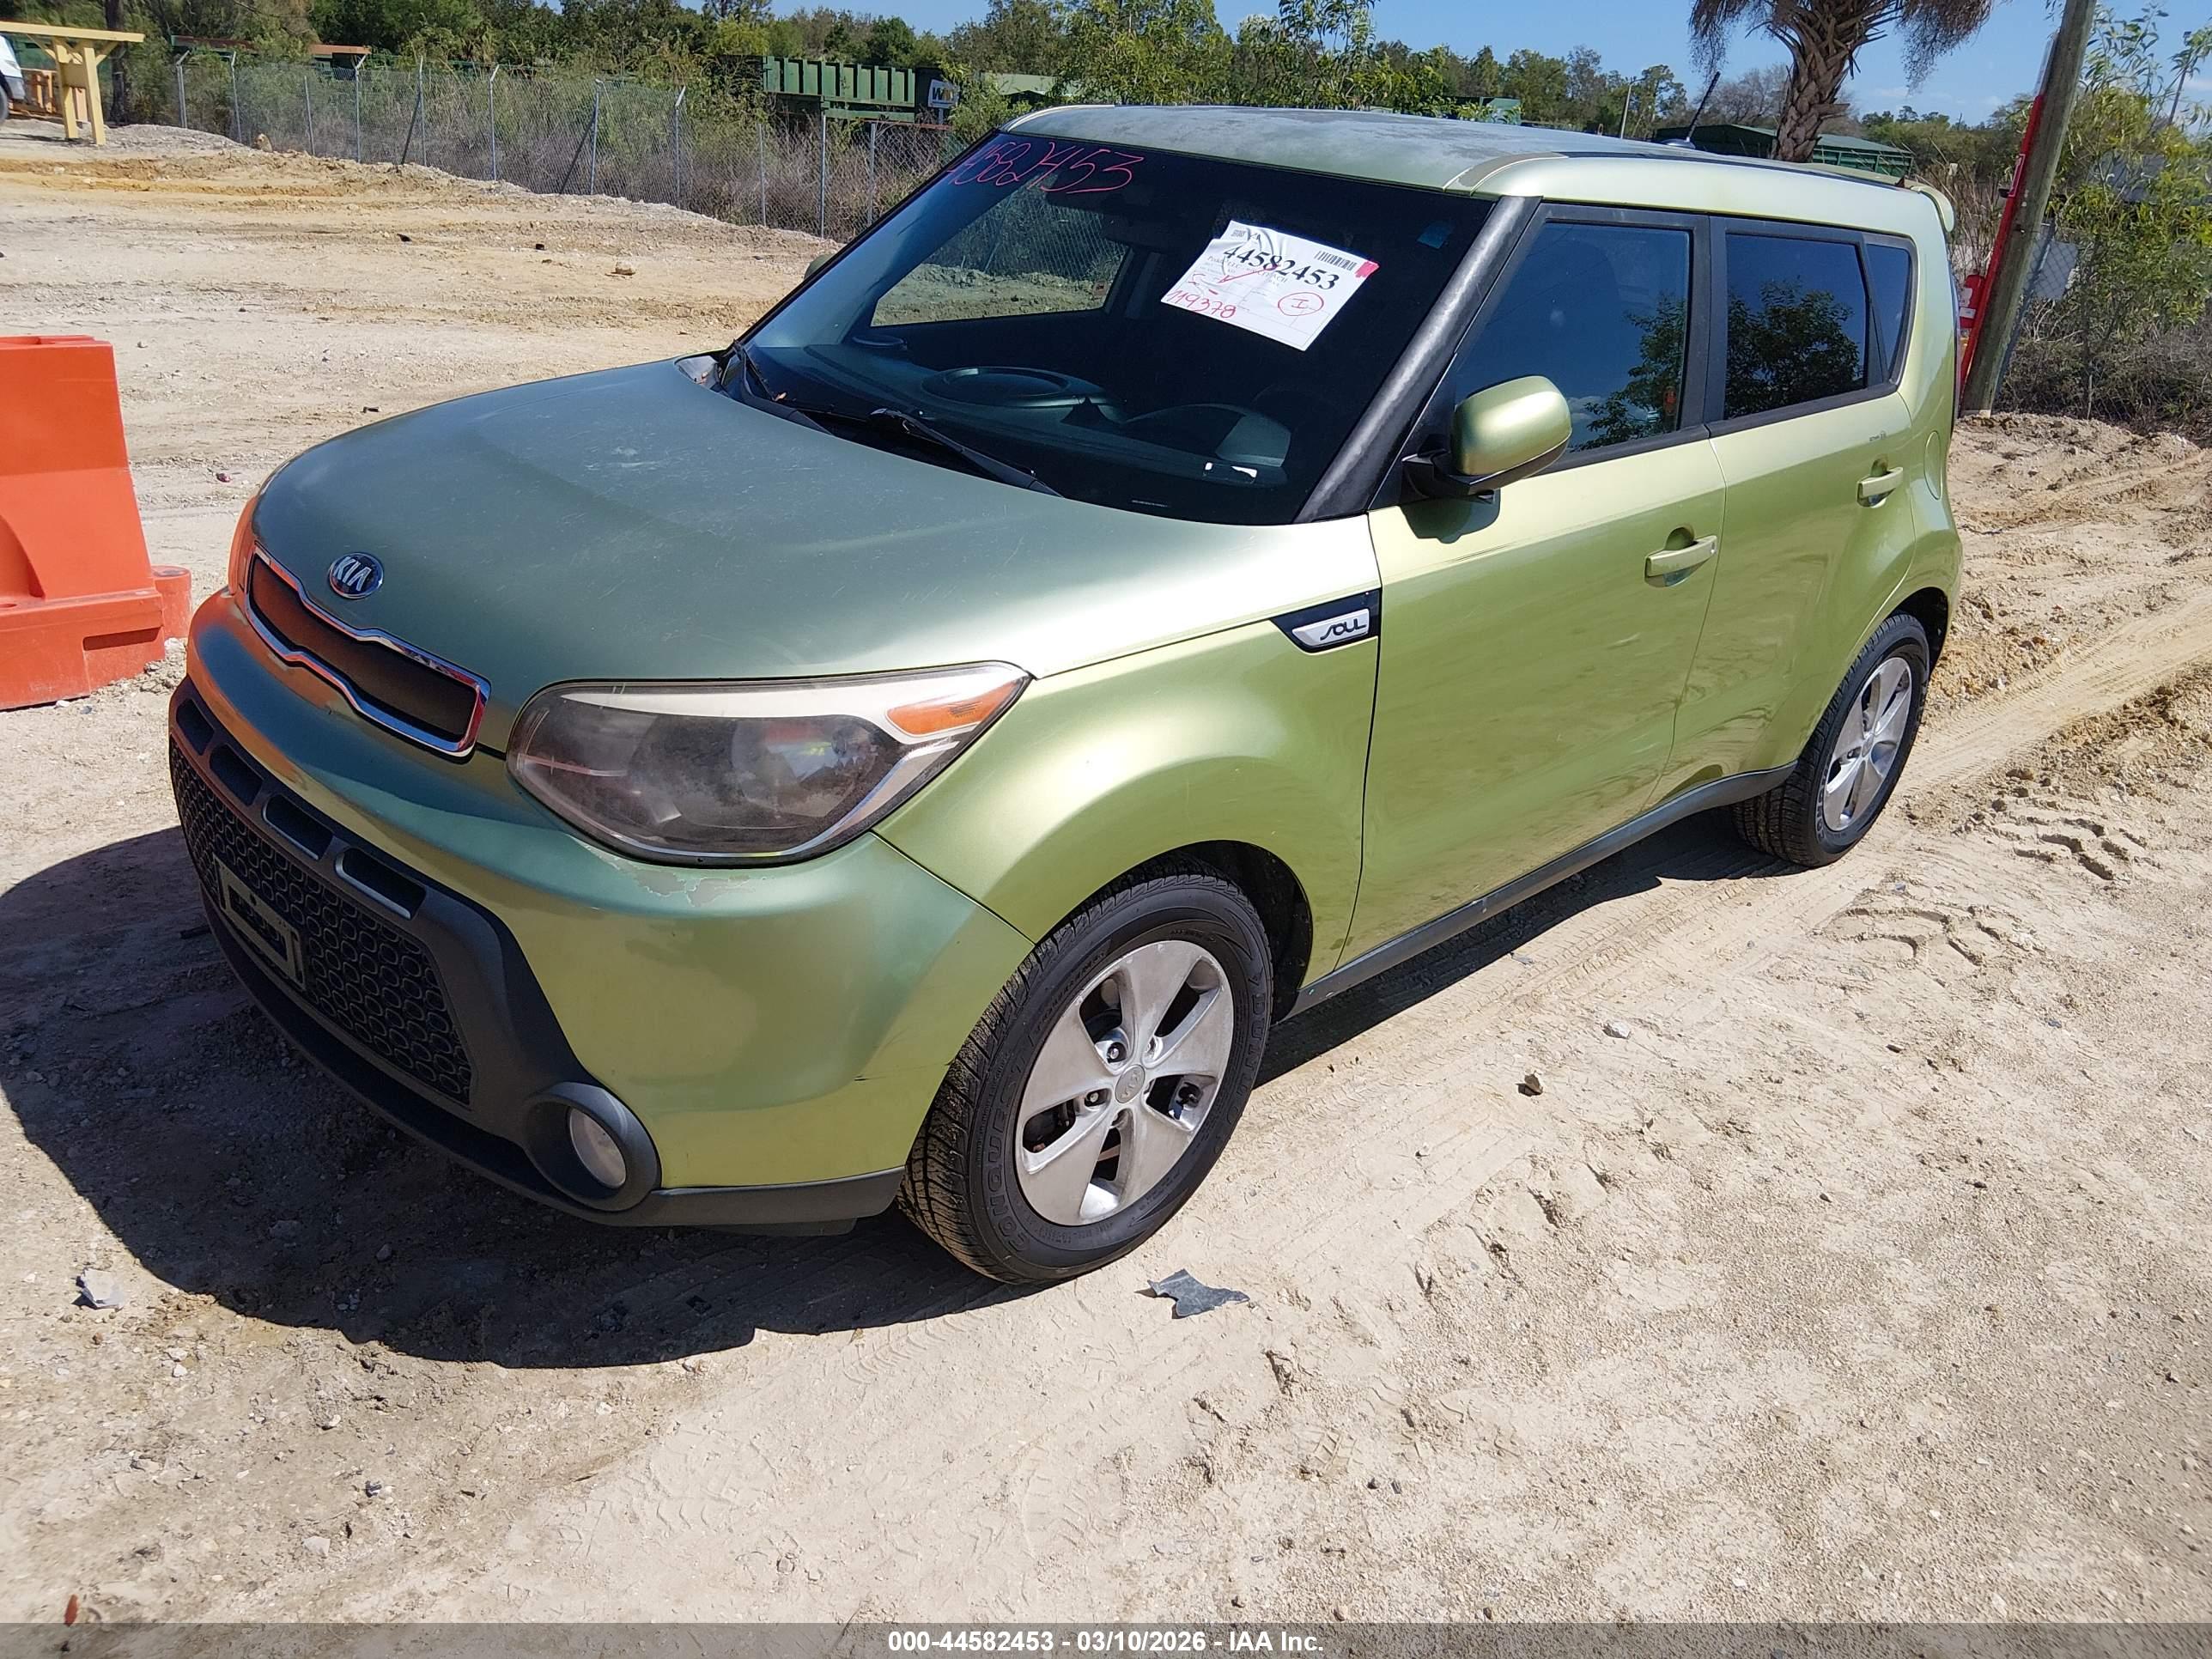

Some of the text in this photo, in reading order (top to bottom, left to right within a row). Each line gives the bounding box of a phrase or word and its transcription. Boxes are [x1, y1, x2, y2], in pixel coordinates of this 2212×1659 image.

[1223, 246, 1340, 290] 44582453
[1167, 289, 1237, 319] 119378
[332, 556, 373, 592] KIA
[1319, 617, 1367, 641] SOUL
